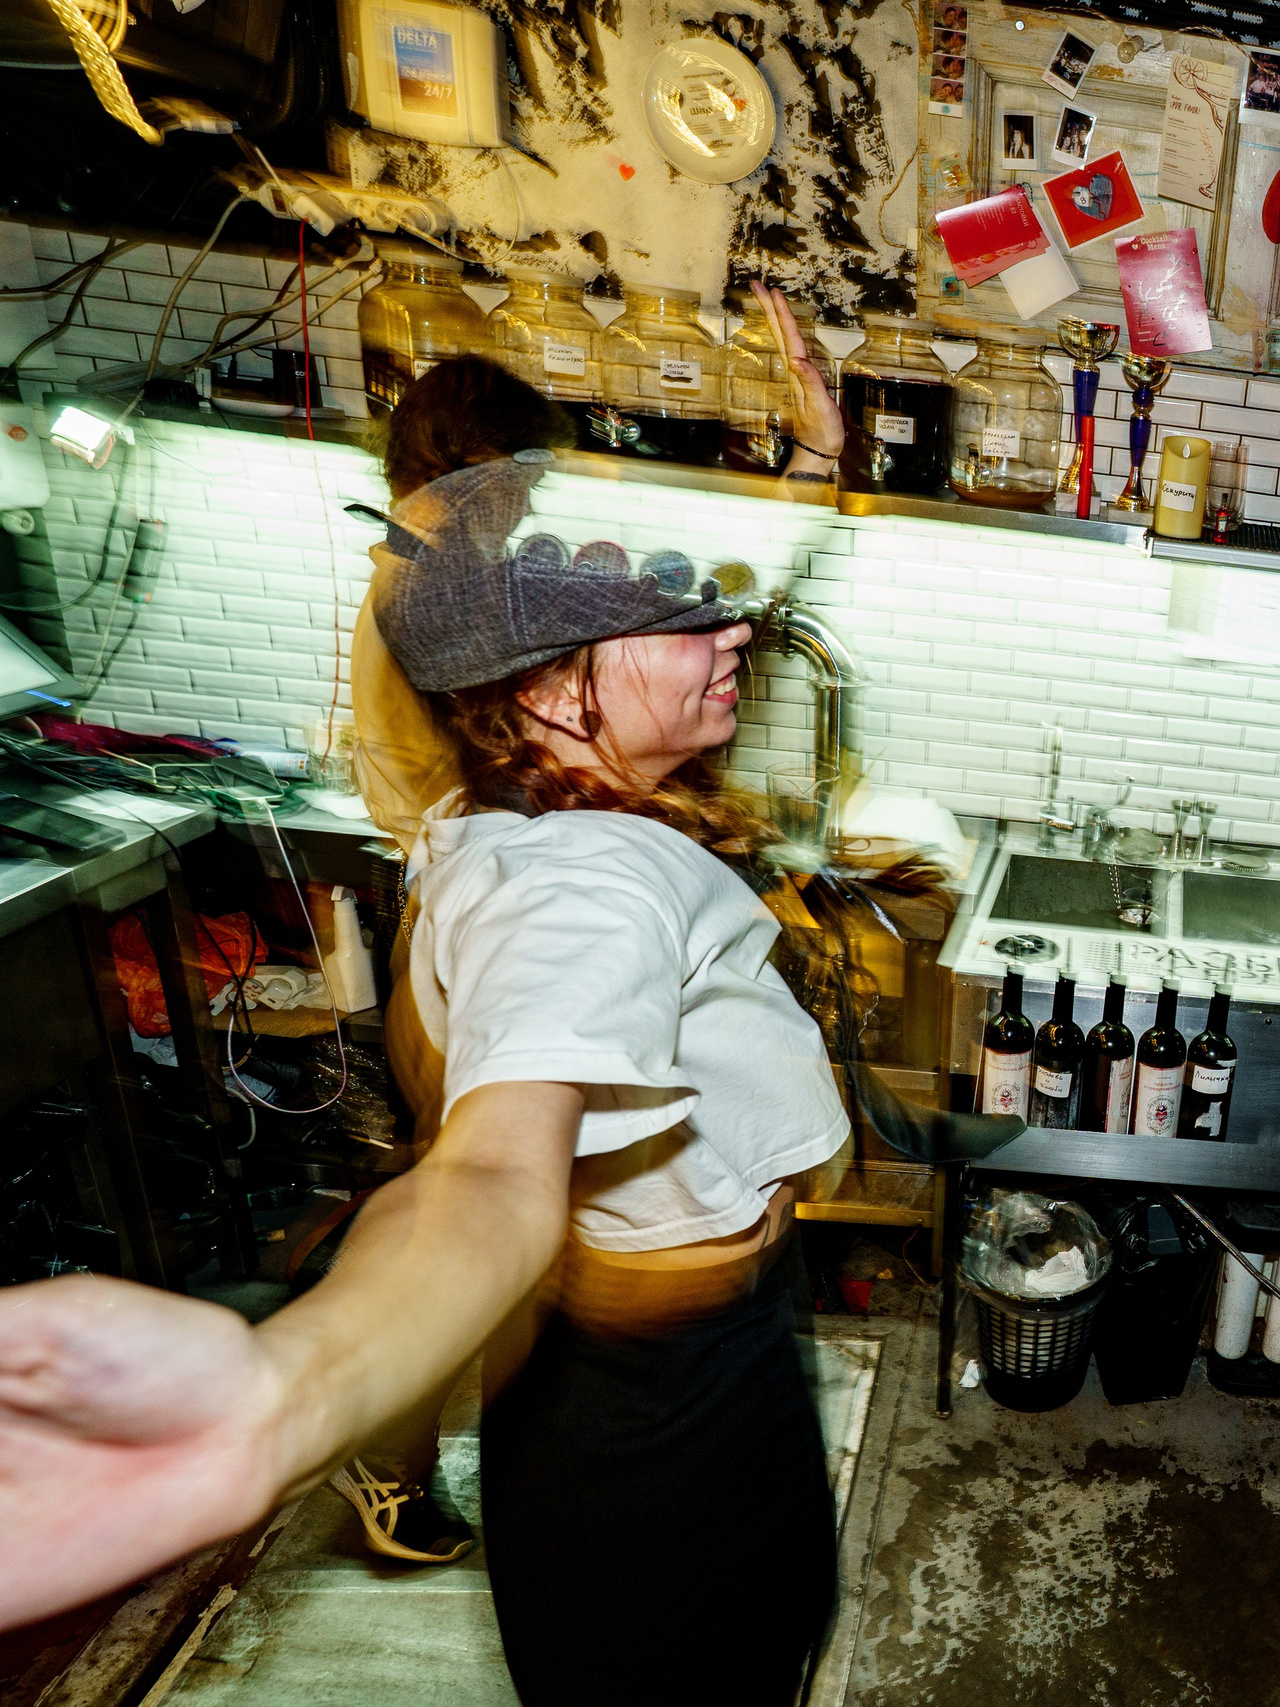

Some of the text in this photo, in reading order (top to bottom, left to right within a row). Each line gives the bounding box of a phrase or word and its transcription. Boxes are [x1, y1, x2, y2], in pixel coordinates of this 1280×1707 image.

[397, 30, 438, 48] DELTA
[424, 84, 452, 99] 24/7
[1141, 234, 1169, 245] Cocktail
[1147, 243, 1166, 251] Menu
[1162, 483, 1195, 500] Секурити
